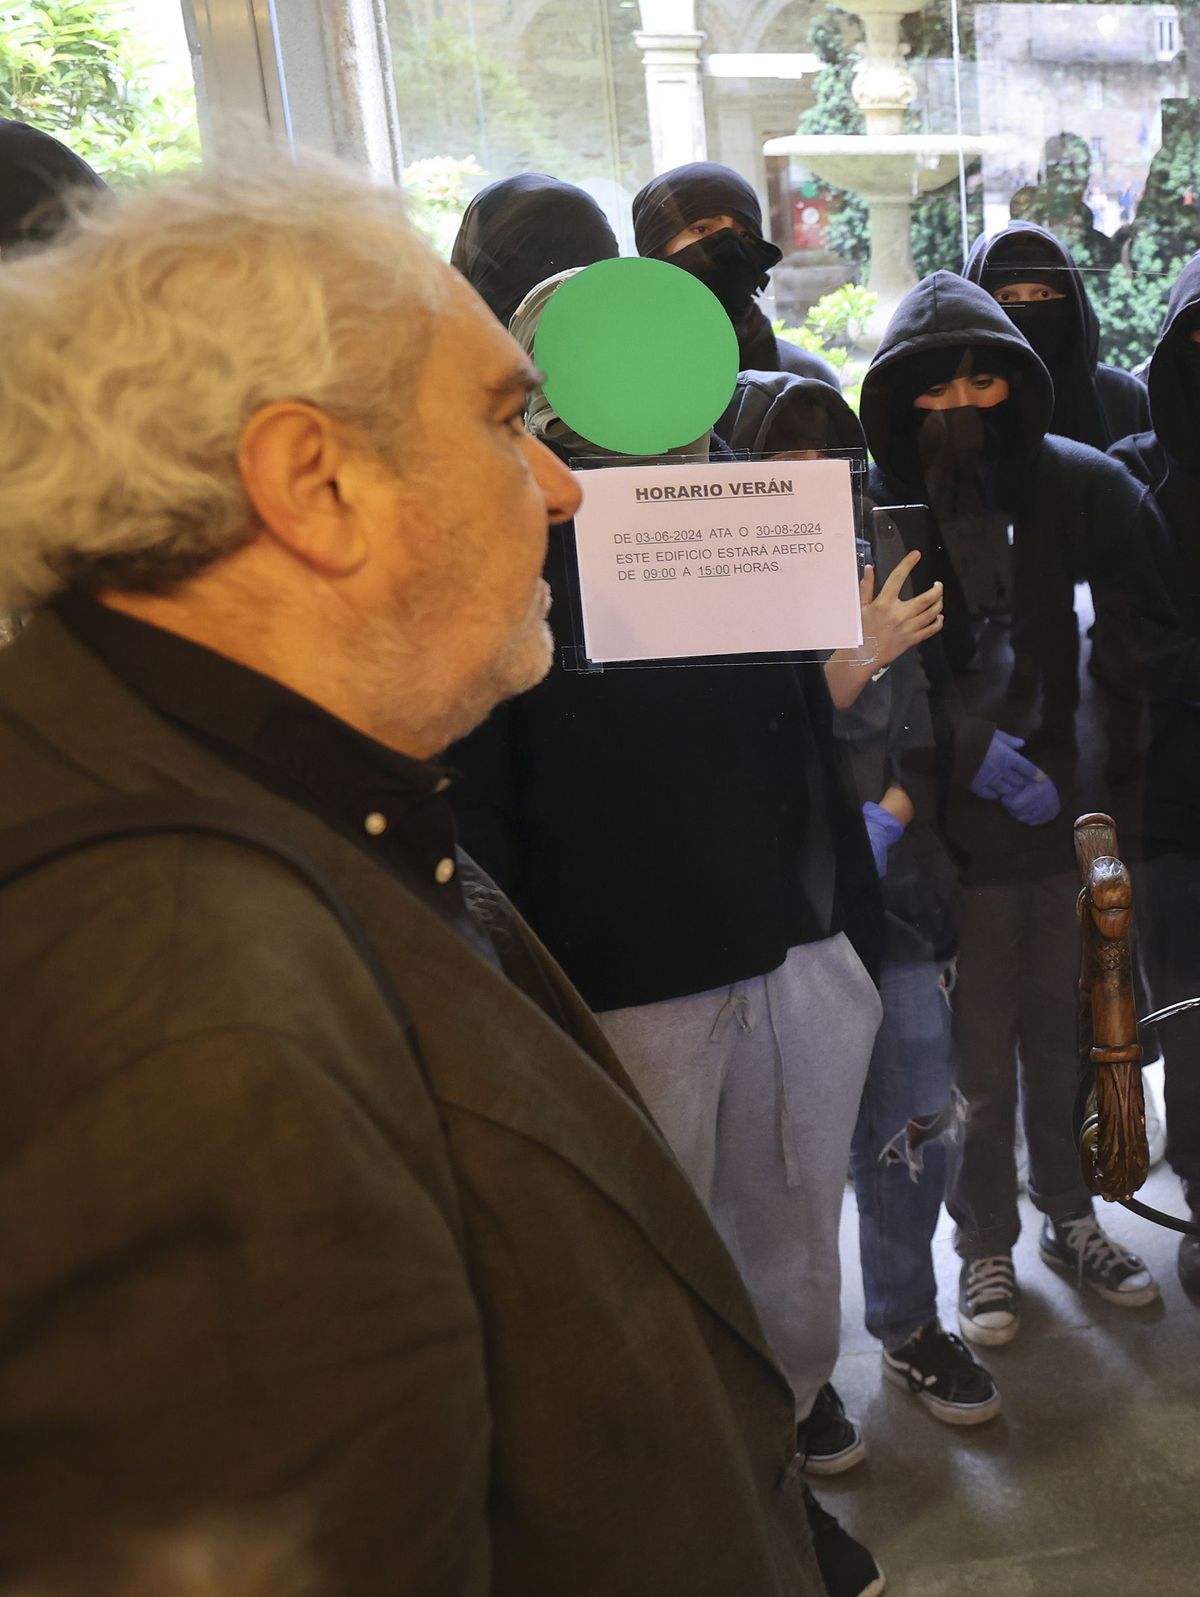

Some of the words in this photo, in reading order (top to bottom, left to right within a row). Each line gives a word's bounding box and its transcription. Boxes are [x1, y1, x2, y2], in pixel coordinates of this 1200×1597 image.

[635, 483, 723, 502] HORARIO
[728, 478, 794, 496] VERÁN
[614, 533, 632, 544] DE
[635, 529, 703, 544] 03-06-2024
[709, 528, 733, 539] ATA
[739, 526, 749, 537] O
[756, 523, 822, 537] 30-08-2024
[616, 552, 650, 564] ESTE
[656, 549, 712, 562] EDIFICIO
[718, 544, 768, 558] ESTARÁ
[772, 542, 824, 555] ABERTO
[618, 570, 636, 581] DE
[643, 567, 677, 580] 09:00
[683, 566, 692, 577] A
[698, 564, 731, 577] 15:00
[734, 561, 783, 574] HORAS.
